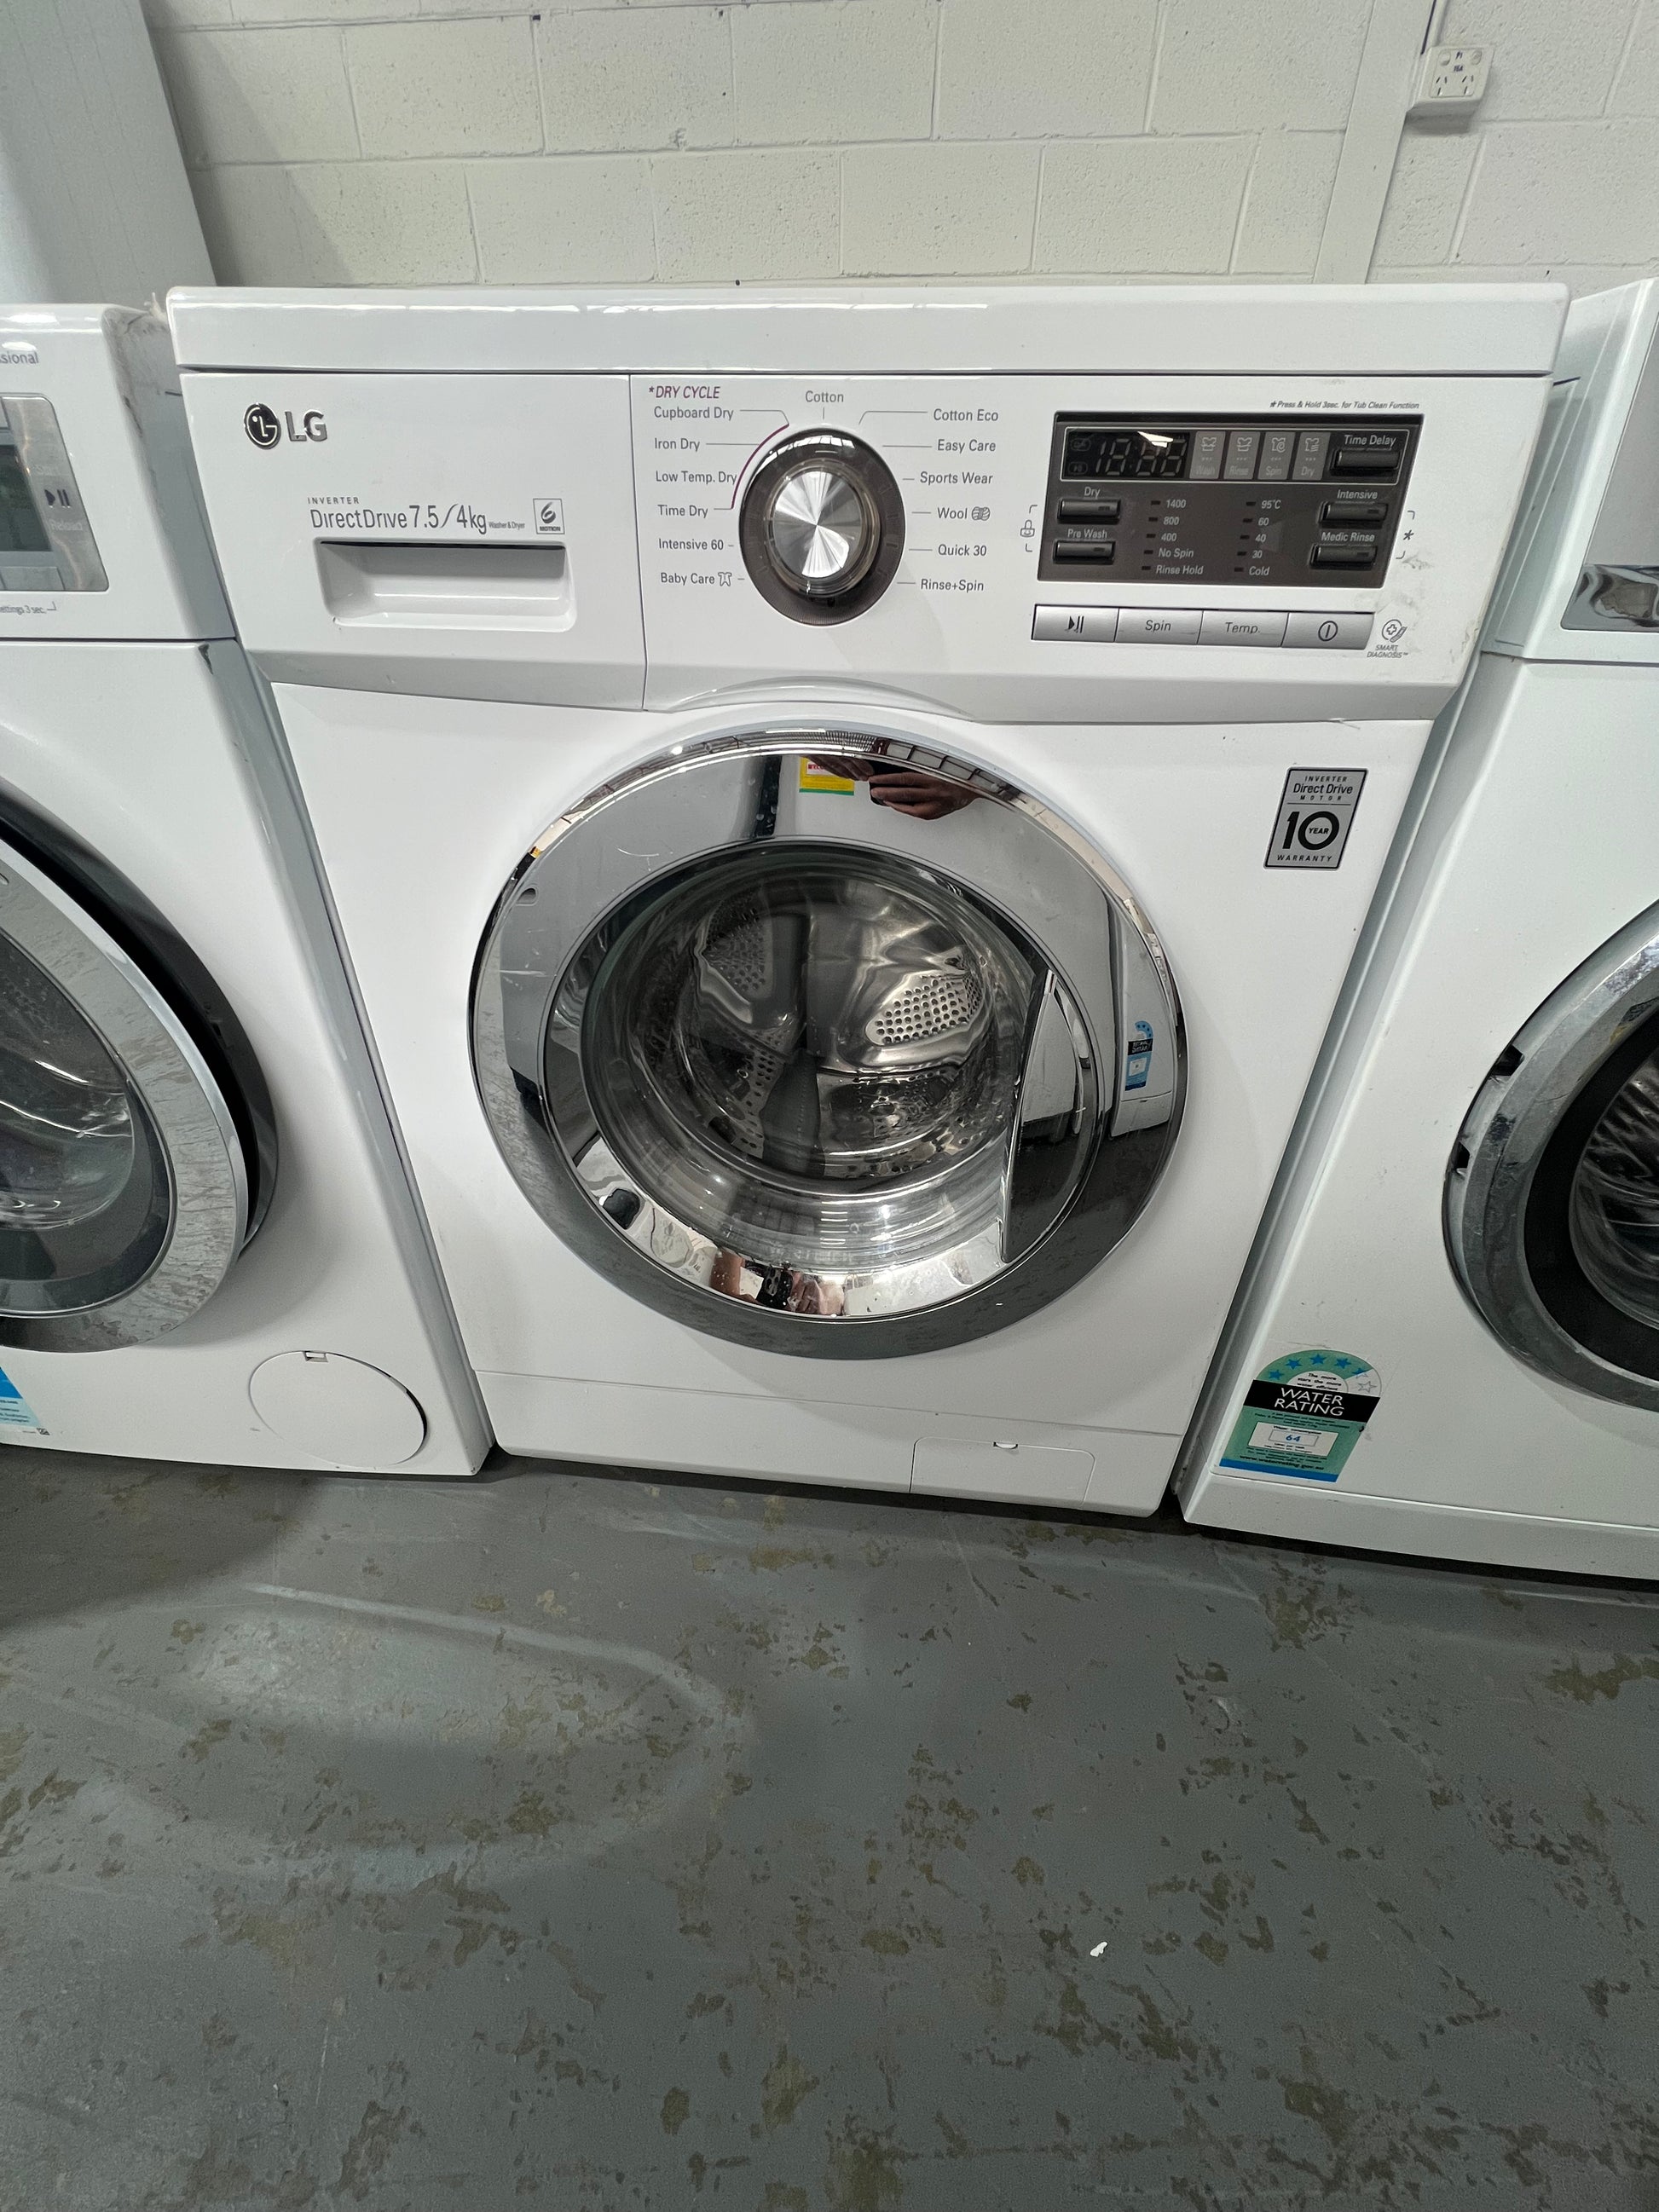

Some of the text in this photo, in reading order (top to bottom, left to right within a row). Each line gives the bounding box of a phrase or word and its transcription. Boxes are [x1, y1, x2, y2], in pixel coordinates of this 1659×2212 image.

[0, 350, 39, 364] sional
[683, 386, 720, 399] CYCLE
[805, 390, 844, 403] Cotton
[654, 406, 734, 421] Cupboard Dry
[933, 408, 999, 422] Cotton Eco
[285, 409, 328, 442] LG
[655, 438, 701, 452] Iron Dry
[937, 439, 997, 454] Easy Care
[1344, 435, 1396, 448] Time Delay
[1300, 466, 1315, 476] Dry
[656, 471, 737, 486] Low Temp. Dry
[920, 471, 993, 486] Sports Wear
[1084, 487, 1101, 497] Dry
[1337, 489, 1378, 500] Intensive
[1166, 500, 1187, 508] 1400
[1261, 500, 1281, 510] 95°C
[657, 505, 708, 518] Time Dry
[937, 507, 968, 520] Wool
[408, 503, 487, 535] 7.5/4kg
[1163, 517, 1179, 525] 800
[1257, 517, 1269, 526] 60
[1067, 529, 1107, 539] Pre Wash
[1161, 533, 1177, 541] 400
[1255, 534, 1266, 543] 40
[1321, 532, 1375, 542] Medic Rinse
[658, 538, 724, 550] Intensive 60
[938, 544, 987, 557] Quick 30
[1159, 548, 1194, 560] No Spin
[1251, 551, 1263, 559] 30
[1156, 565, 1204, 575] Rinse Hold
[1249, 566, 1270, 576] Cold
[661, 572, 715, 586] Baby Care
[921, 579, 984, 593] Rinse+Spin
[25, 604, 31, 614] 3
[1145, 620, 1171, 632] Spin
[1224, 622, 1261, 634] Temp.
[1293, 783, 1353, 794] Direct Drive
[1282, 811, 1339, 851] 10
[1280, 1387, 1344, 1406] WATER
[1274, 1398, 1345, 1417] RATING
